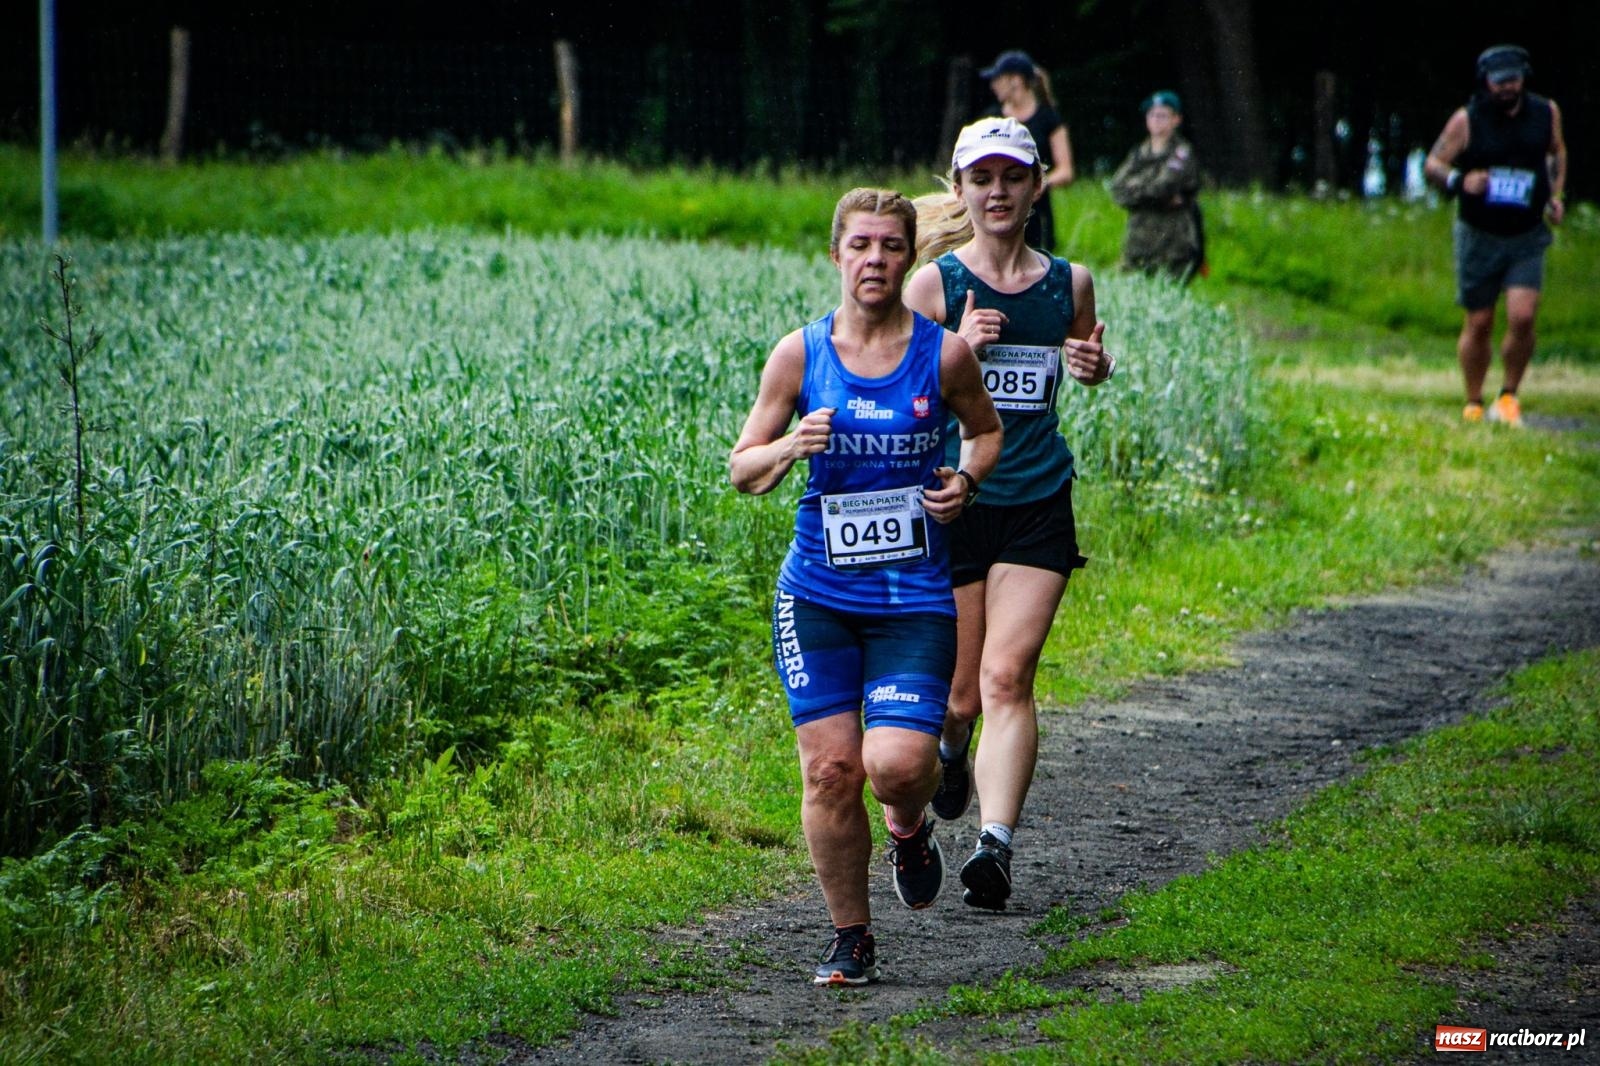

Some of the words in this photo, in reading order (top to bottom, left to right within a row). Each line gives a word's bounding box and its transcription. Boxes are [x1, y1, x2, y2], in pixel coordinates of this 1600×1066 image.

[984, 370, 1037, 394] 085
[824, 427, 940, 455] UNNERS
[889, 459, 921, 469] TEAM
[842, 500, 860, 508] BIEG
[862, 499, 875, 507] NA
[841, 518, 901, 547] 049
